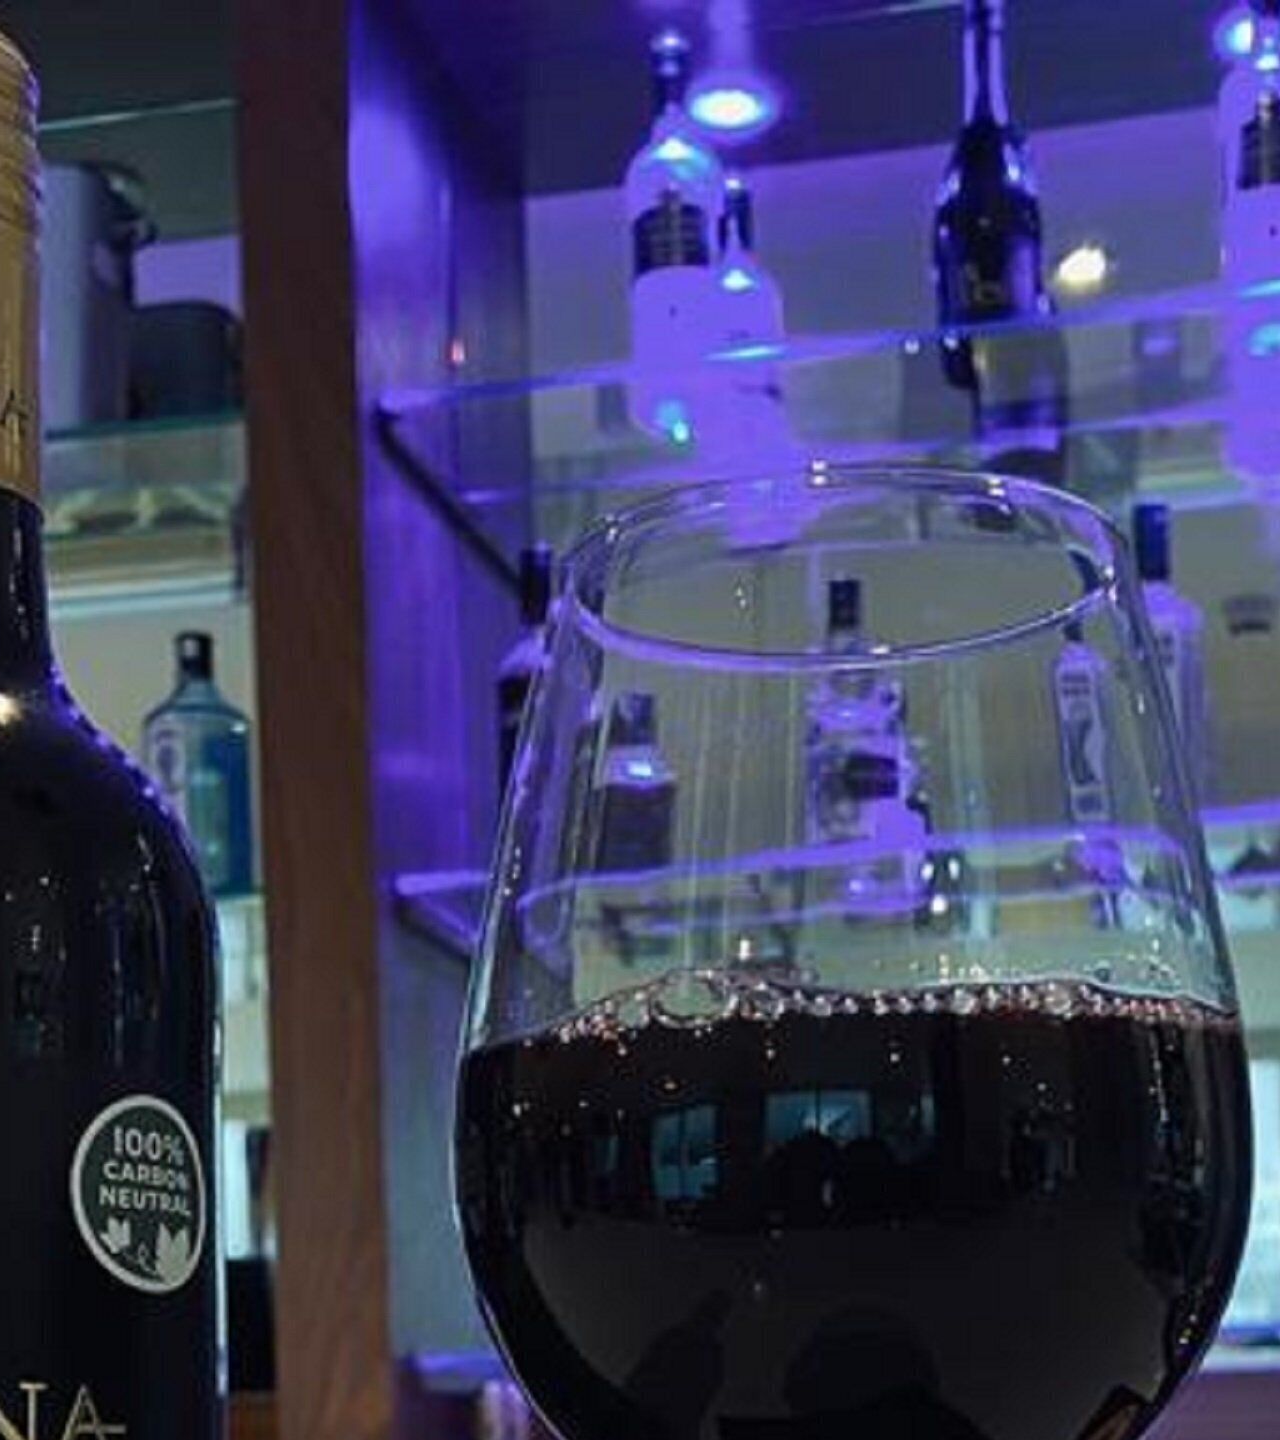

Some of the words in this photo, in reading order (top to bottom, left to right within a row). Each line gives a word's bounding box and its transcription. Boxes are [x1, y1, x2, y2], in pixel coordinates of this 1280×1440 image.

[113, 1126, 185, 1168] 100%
[103, 1160, 188, 1192] CARBON
[99, 1184, 192, 1216] NEUTRAL
